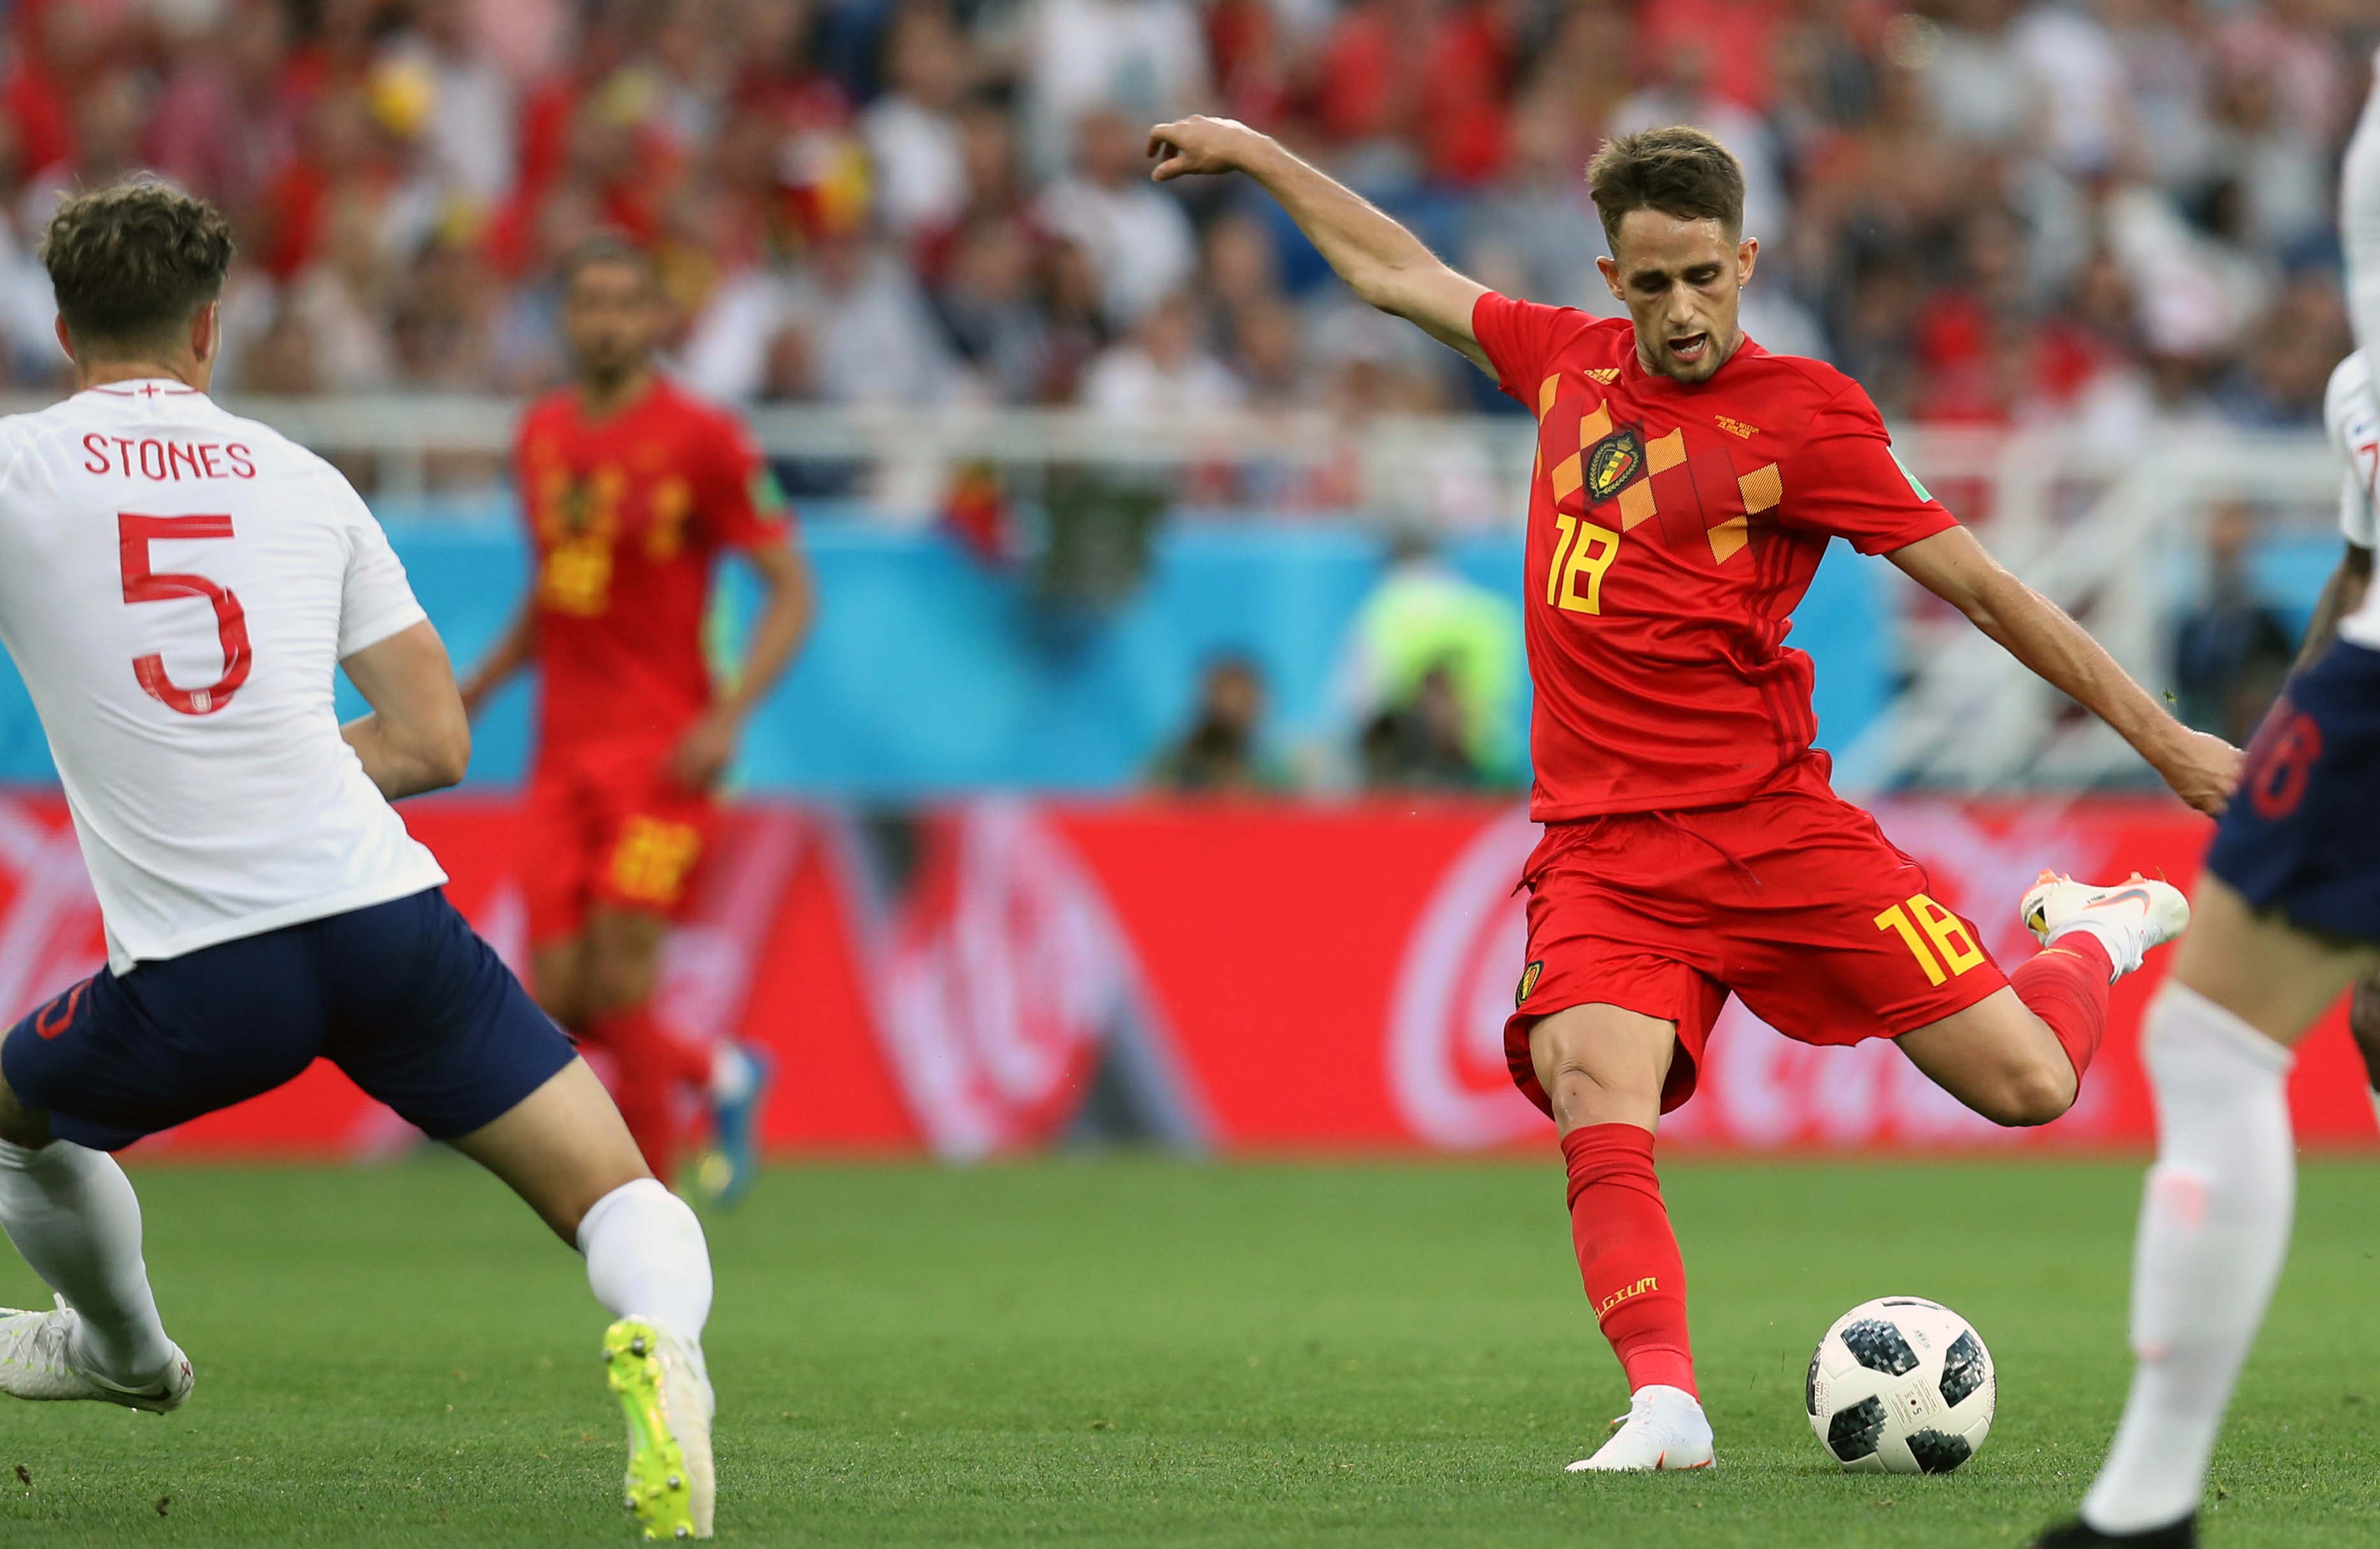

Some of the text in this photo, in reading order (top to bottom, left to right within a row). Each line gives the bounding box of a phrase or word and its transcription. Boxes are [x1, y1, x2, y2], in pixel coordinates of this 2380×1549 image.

[84, 433, 256, 481] STONES
[1546, 512, 1620, 616] 18
[118, 511, 252, 716] 5
[1873, 893, 1986, 987] 18
[1913, 1407, 1923, 1415] 5
